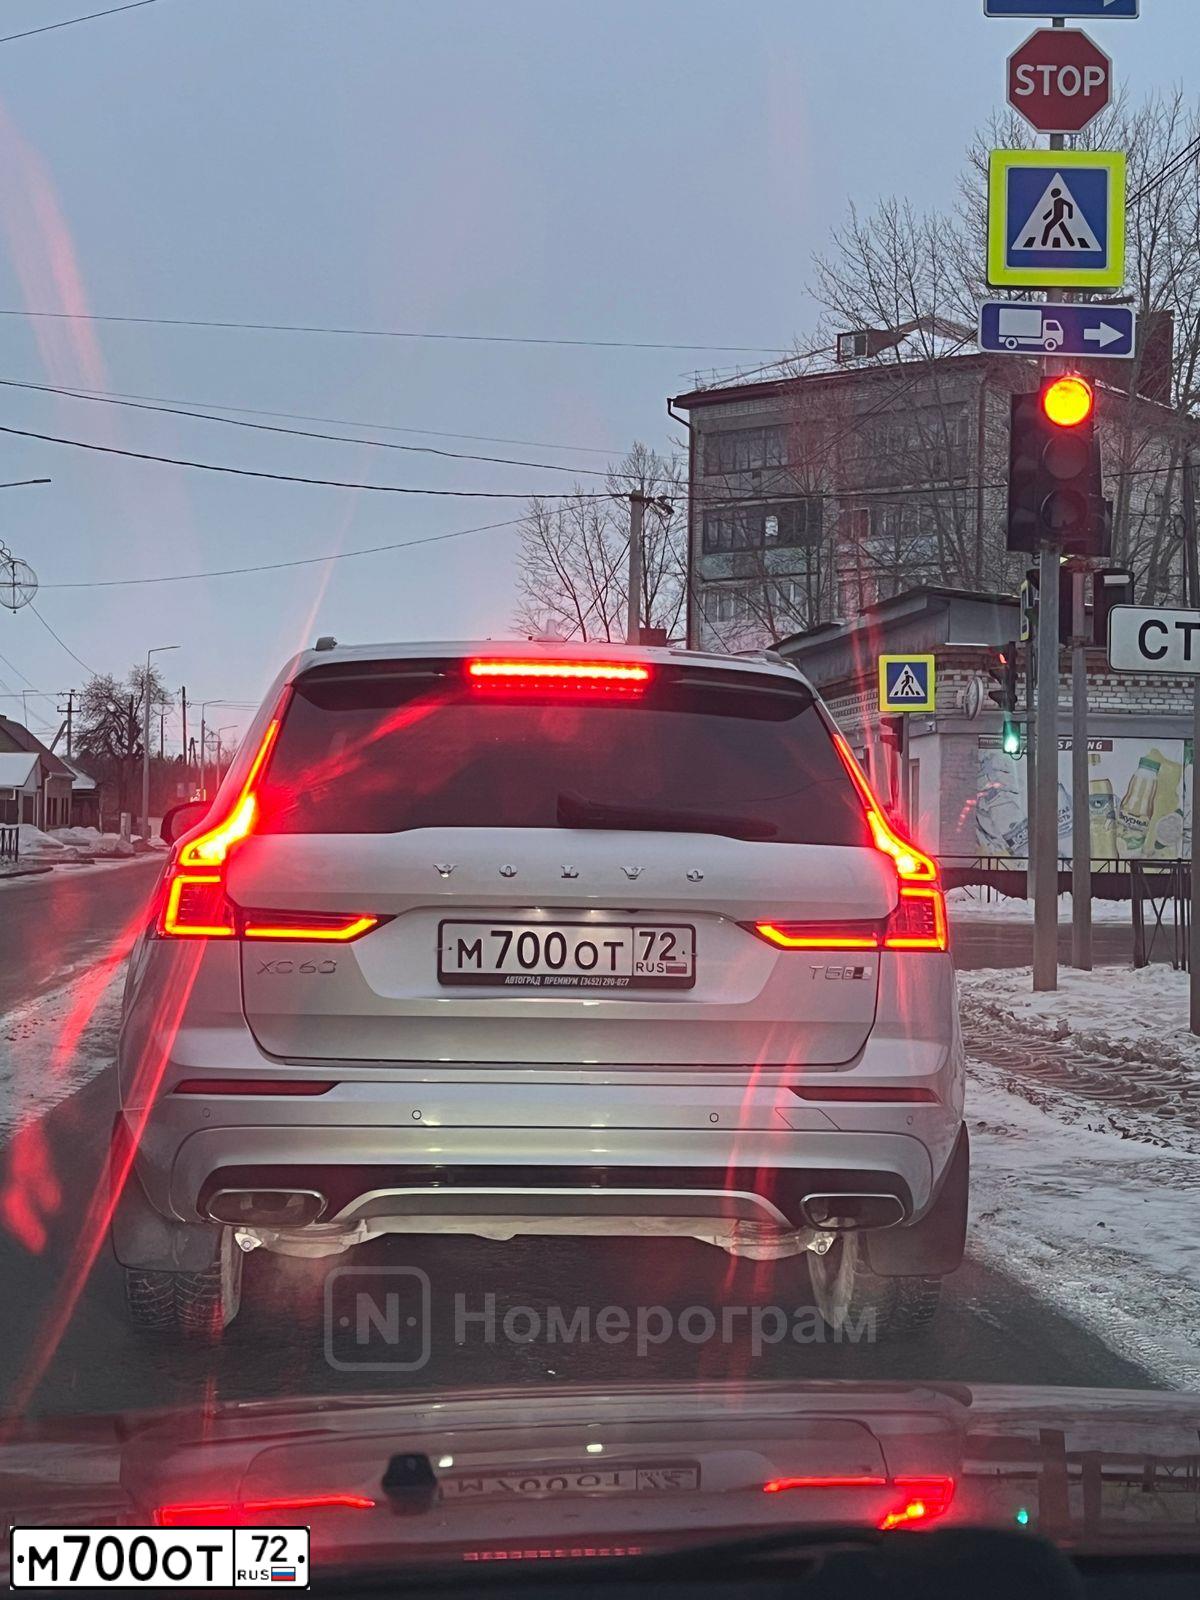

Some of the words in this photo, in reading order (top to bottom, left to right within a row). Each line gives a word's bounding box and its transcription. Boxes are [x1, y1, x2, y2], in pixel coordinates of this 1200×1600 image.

[1014, 64, 1106, 97] STOP
[1057, 740, 1103, 751] SPNG
[432, 862, 706, 883] VOLVO
[457, 930, 624, 972] М700ОТ
[638, 931, 677, 962] 72
[635, 961, 665, 974] RUS
[504, 975, 541, 986] АВТОГРАД
[543, 975, 579, 986] ПРЕМИУМ
